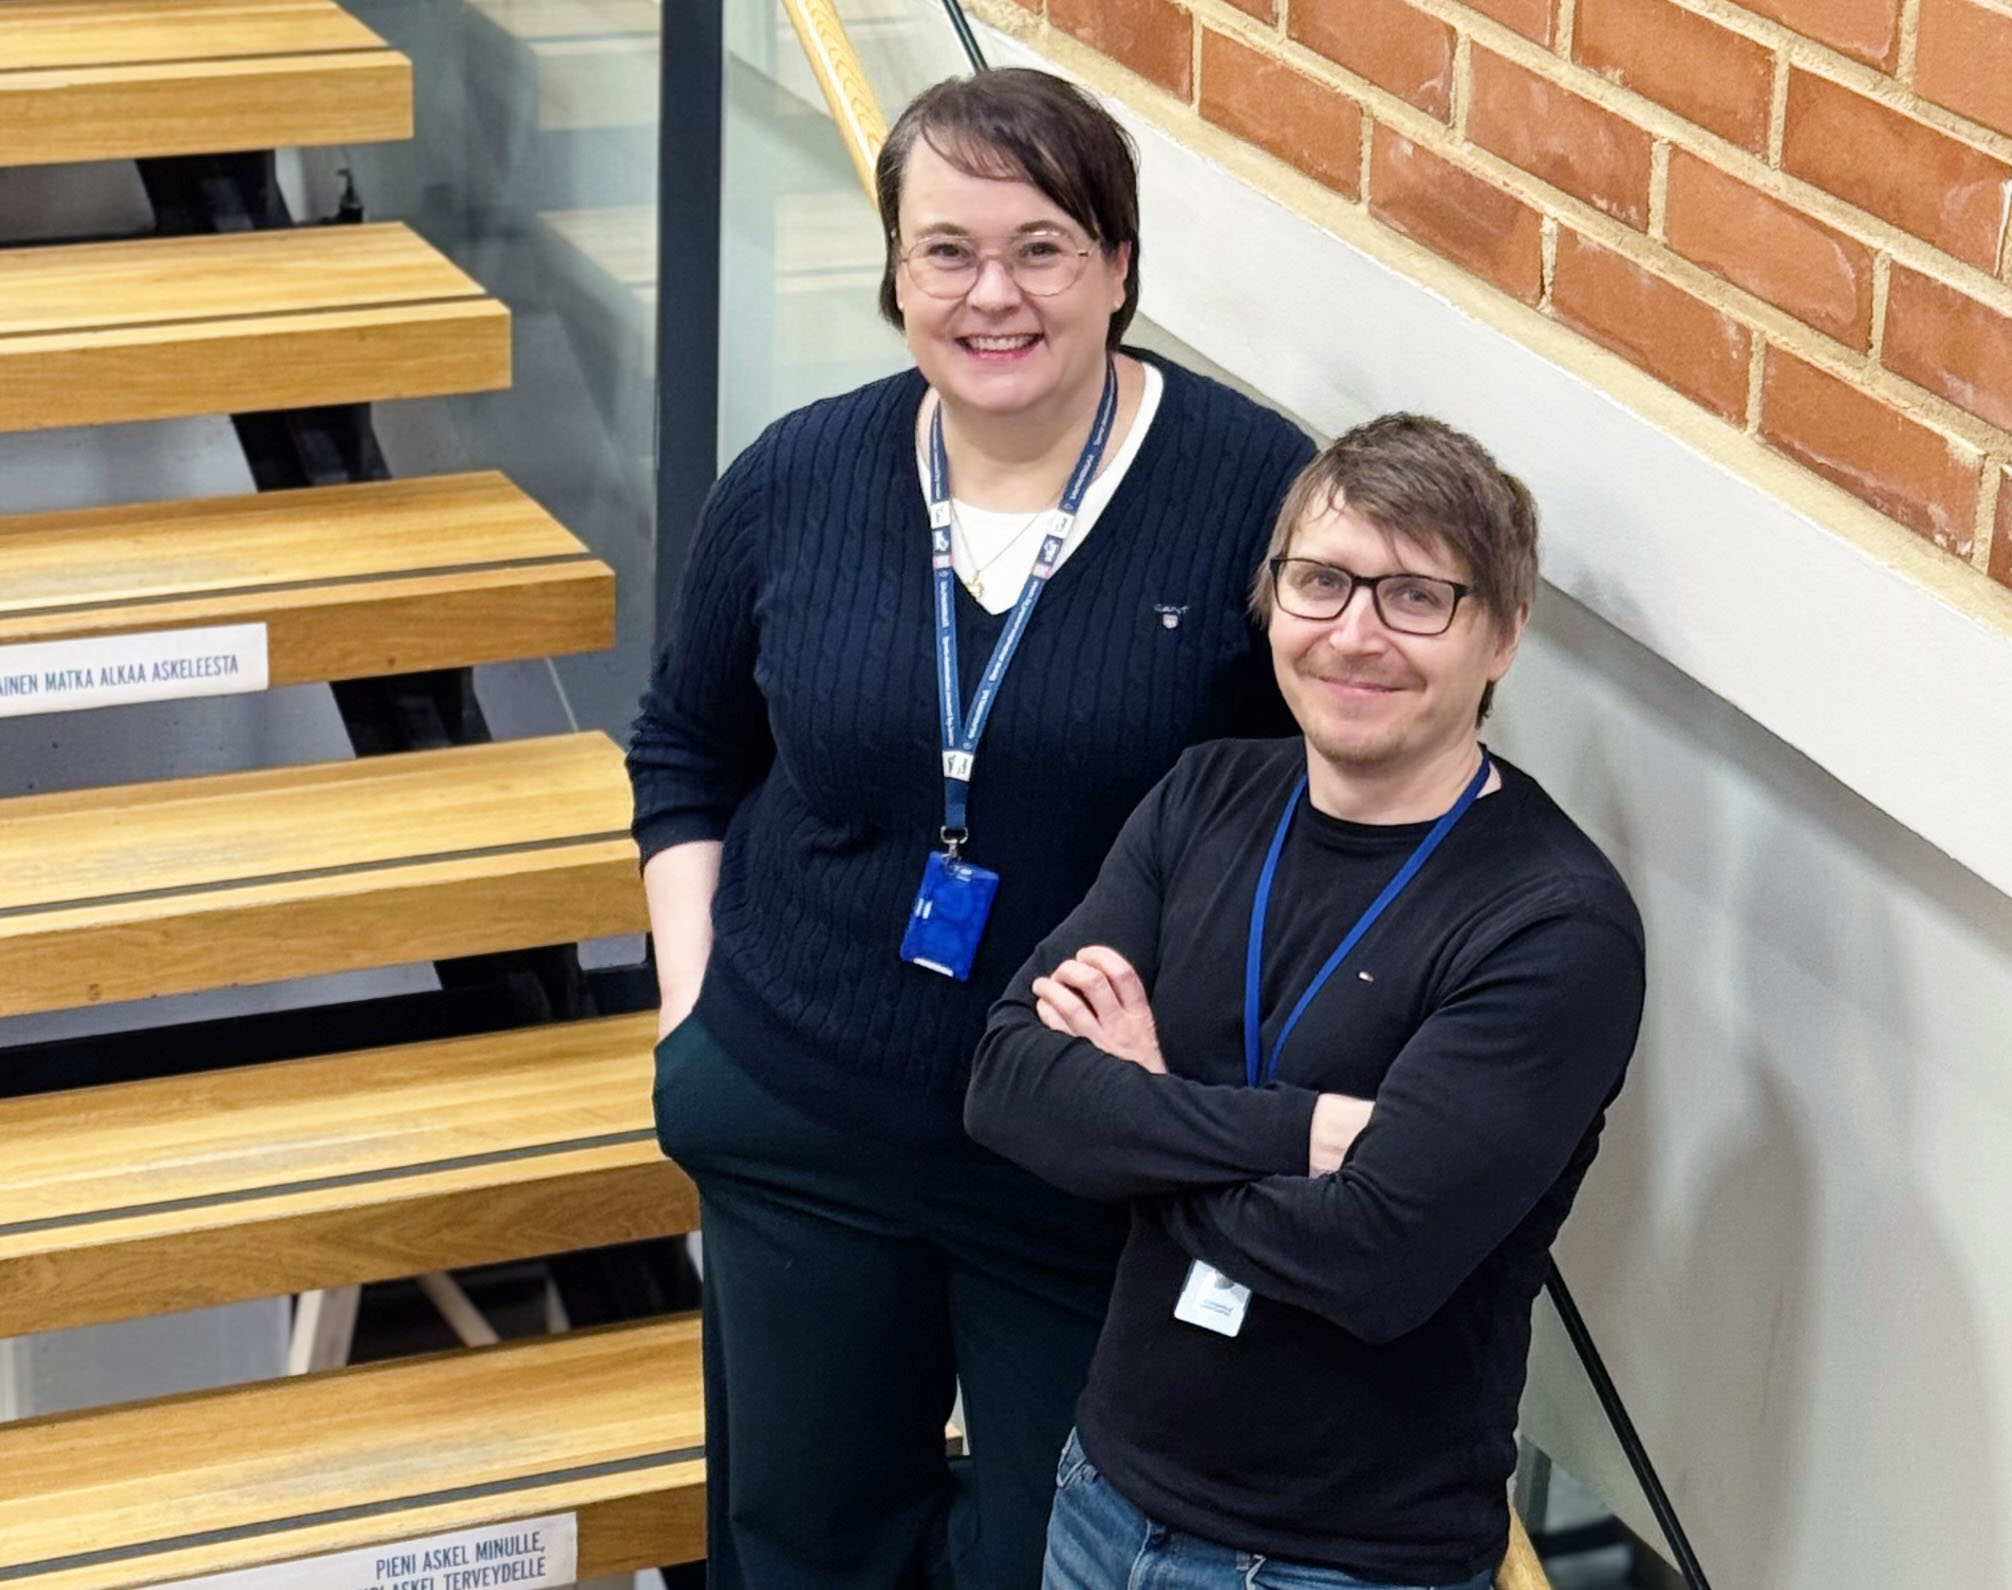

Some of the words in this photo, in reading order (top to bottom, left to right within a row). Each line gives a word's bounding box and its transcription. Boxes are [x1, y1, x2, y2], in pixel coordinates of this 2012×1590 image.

[45, 668, 94, 692] MATKA
[100, 664, 146, 686] ALKAA
[152, 655, 239, 682] ASKELEESTA
[376, 1554, 416, 1580] PIENI
[422, 1545, 469, 1572] ASKEL
[476, 1531, 546, 1562] MINULLE,
[443, 1556, 546, 1590] TERVEYDELLE
